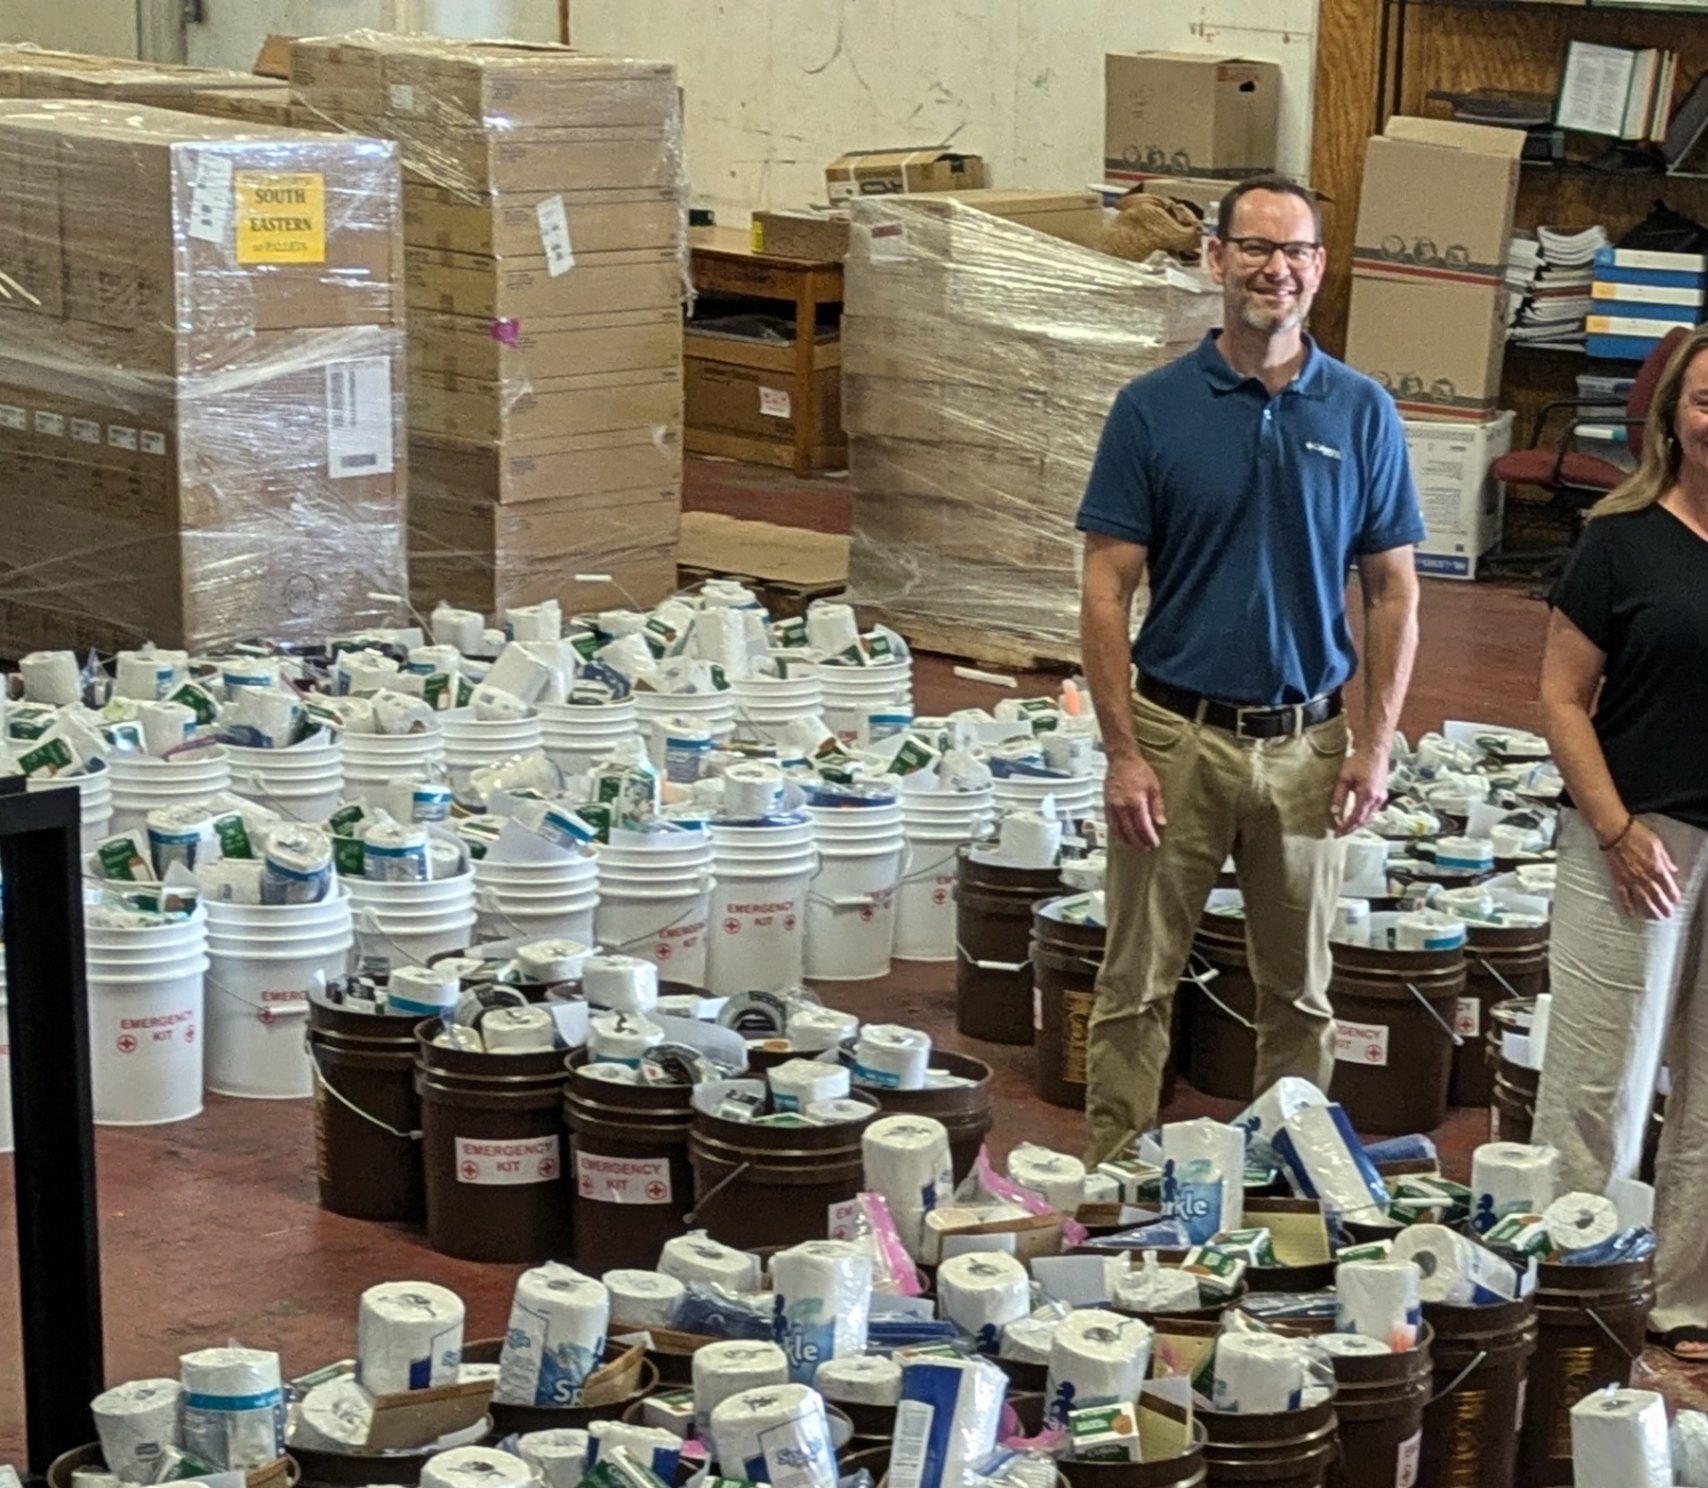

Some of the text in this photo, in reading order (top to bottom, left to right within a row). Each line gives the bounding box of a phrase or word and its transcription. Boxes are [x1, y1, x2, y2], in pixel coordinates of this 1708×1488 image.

[255, 188, 306, 204] SOUTH
[250, 217, 312, 232] EASTERN
[120, 1011, 193, 1029] EMERGENCY
[153, 1030, 172, 1041] KIT
[463, 1142, 552, 1156] EMERGENCY
[496, 1161, 521, 1172] KIT
[581, 1157, 663, 1174] EMERGENCY
[607, 1180, 629, 1191] KIT
